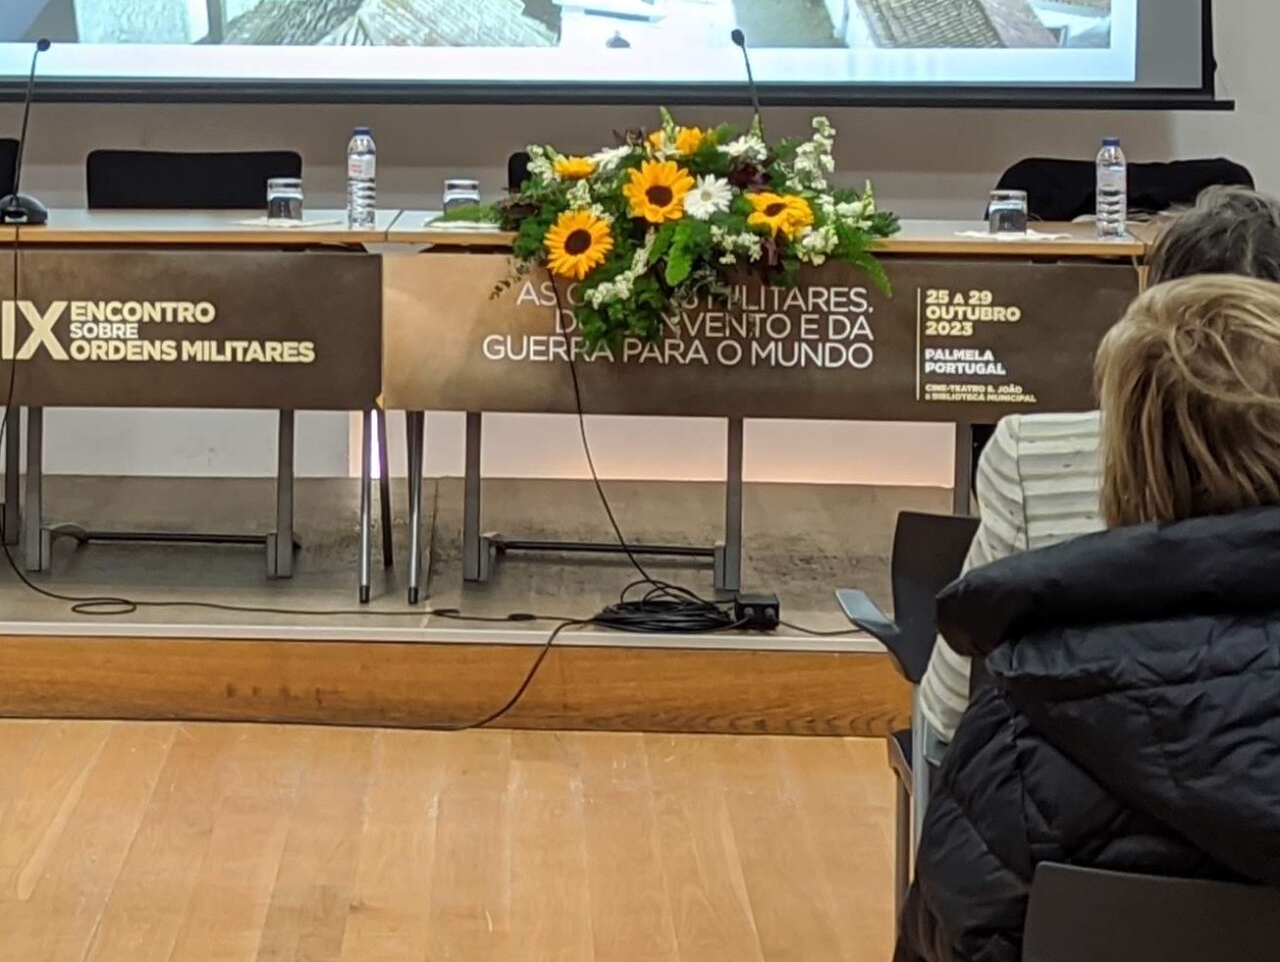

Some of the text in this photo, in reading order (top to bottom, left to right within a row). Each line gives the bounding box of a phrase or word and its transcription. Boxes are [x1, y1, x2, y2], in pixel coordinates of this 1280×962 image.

[516, 280, 557, 307] AS
[925, 289, 993, 305] 25 A 29
[70, 301, 216, 323] ENCONTRO
[925, 305, 1021, 322] OUTUBRO
[1, 300, 69, 361] IX
[69, 322, 139, 339] SOBRE
[801, 313, 820, 340] E
[828, 314, 875, 341] DA
[925, 321, 974, 336] 2023
[70, 340, 316, 364] ORDENS MILITARES
[482, 334, 875, 369] GUERRA PARA O MUNDO
[924, 348, 995, 361] PALMELA
[924, 361, 1007, 376] PORTUGAL
[986, 393, 1038, 404] MUNICIPAL
